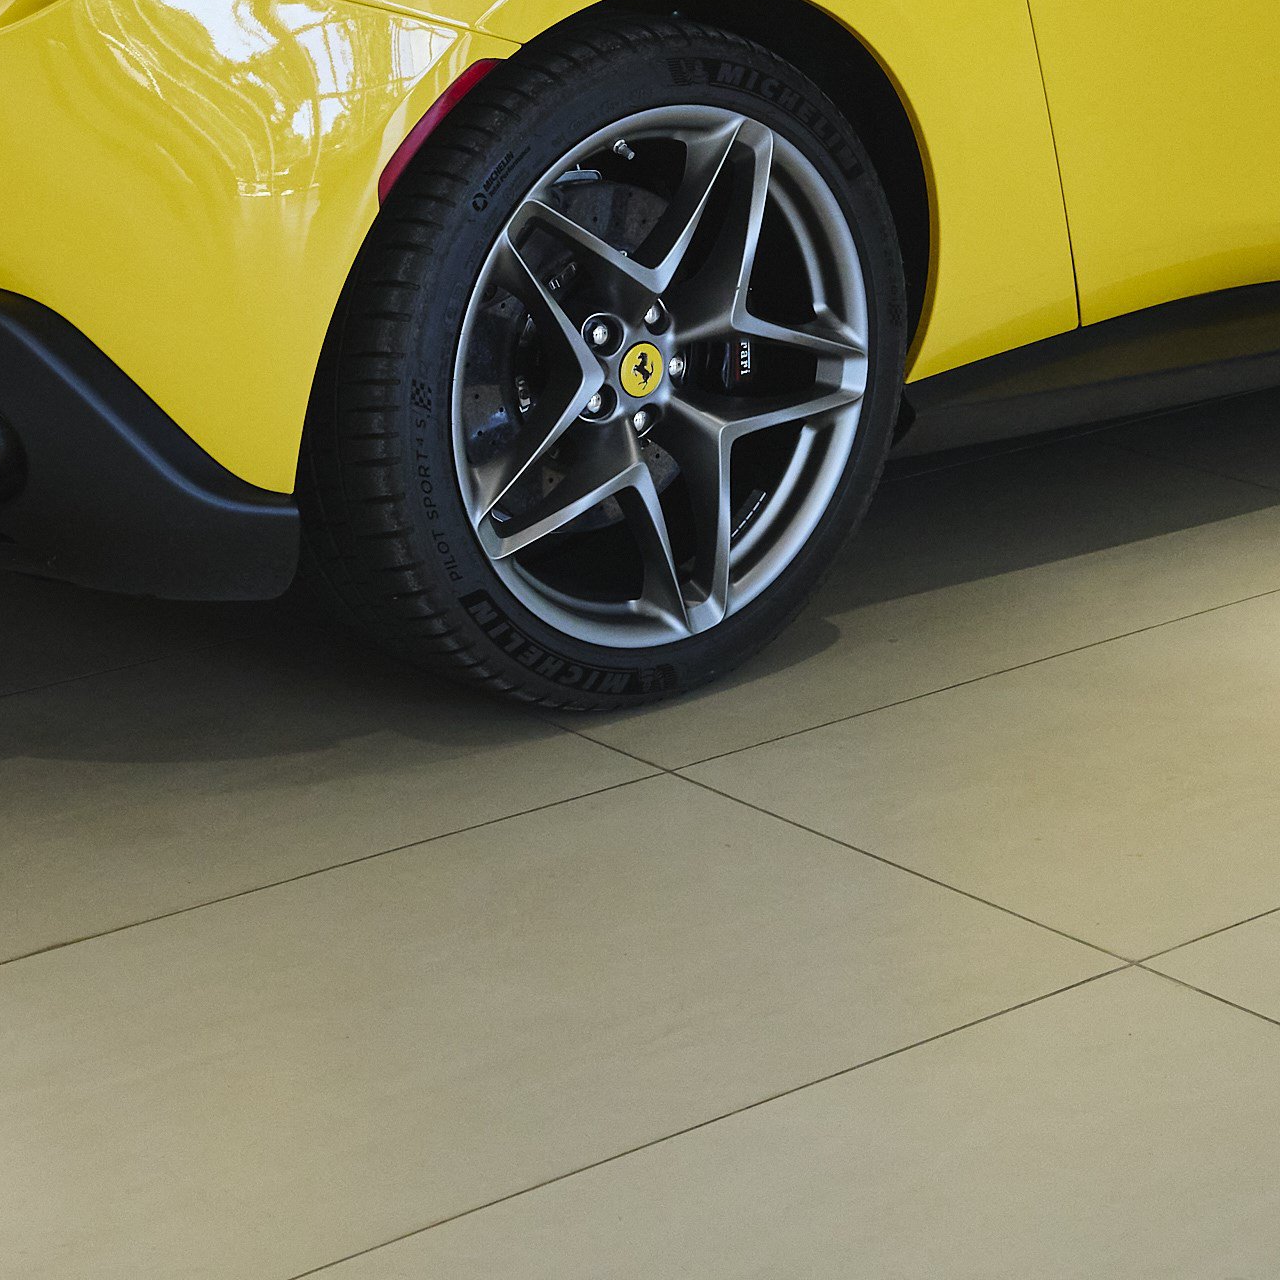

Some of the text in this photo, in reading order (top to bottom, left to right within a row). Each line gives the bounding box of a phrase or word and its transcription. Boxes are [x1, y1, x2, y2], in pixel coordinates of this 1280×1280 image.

[715, 61, 858, 168] MICHELIN
[483, 151, 514, 192] MICHELIN
[416, 450, 439, 520] SPORT
[432, 529, 463, 582] PILOT
[468, 600, 632, 693] MICHELIN
